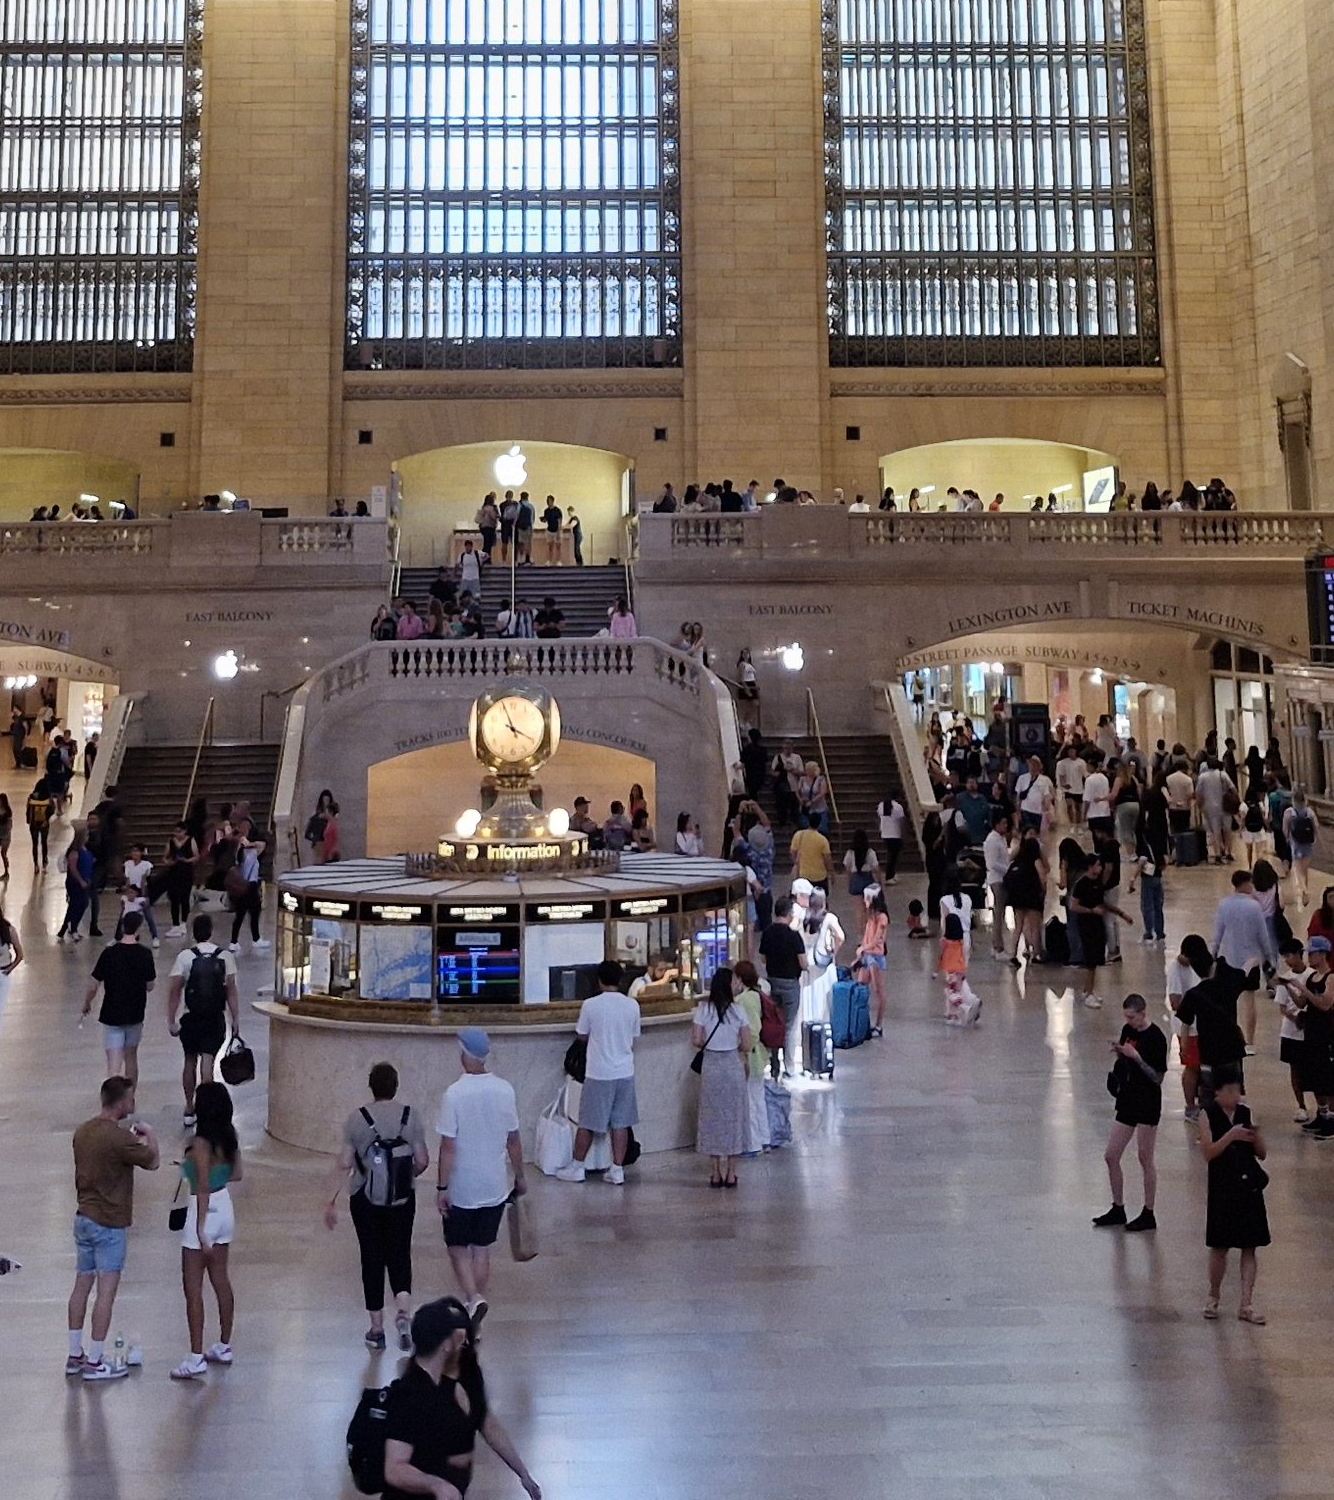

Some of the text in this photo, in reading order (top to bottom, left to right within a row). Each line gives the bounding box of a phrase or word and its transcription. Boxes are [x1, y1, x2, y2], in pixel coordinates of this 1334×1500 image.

[217, 611, 274, 622] BALCONY
[779, 604, 834, 616] BALCONY
[948, 601, 1072, 633] LEXINGTON AVE
[1127, 601, 1265, 636] TICKET MACHINES
[36, 627, 67, 645] AVE
[896, 656, 911, 669] ND
[913, 648, 958, 665] STREET
[963, 644, 1018, 659] PASSAGE
[1025, 645, 1080, 659] SUBWAY
[18, 659, 72, 673] SUBWAY
[394, 732, 434, 750] TRACKS
[564, 724, 646, 752] ING CONCOURSE
[487, 843, 561, 860] Information
